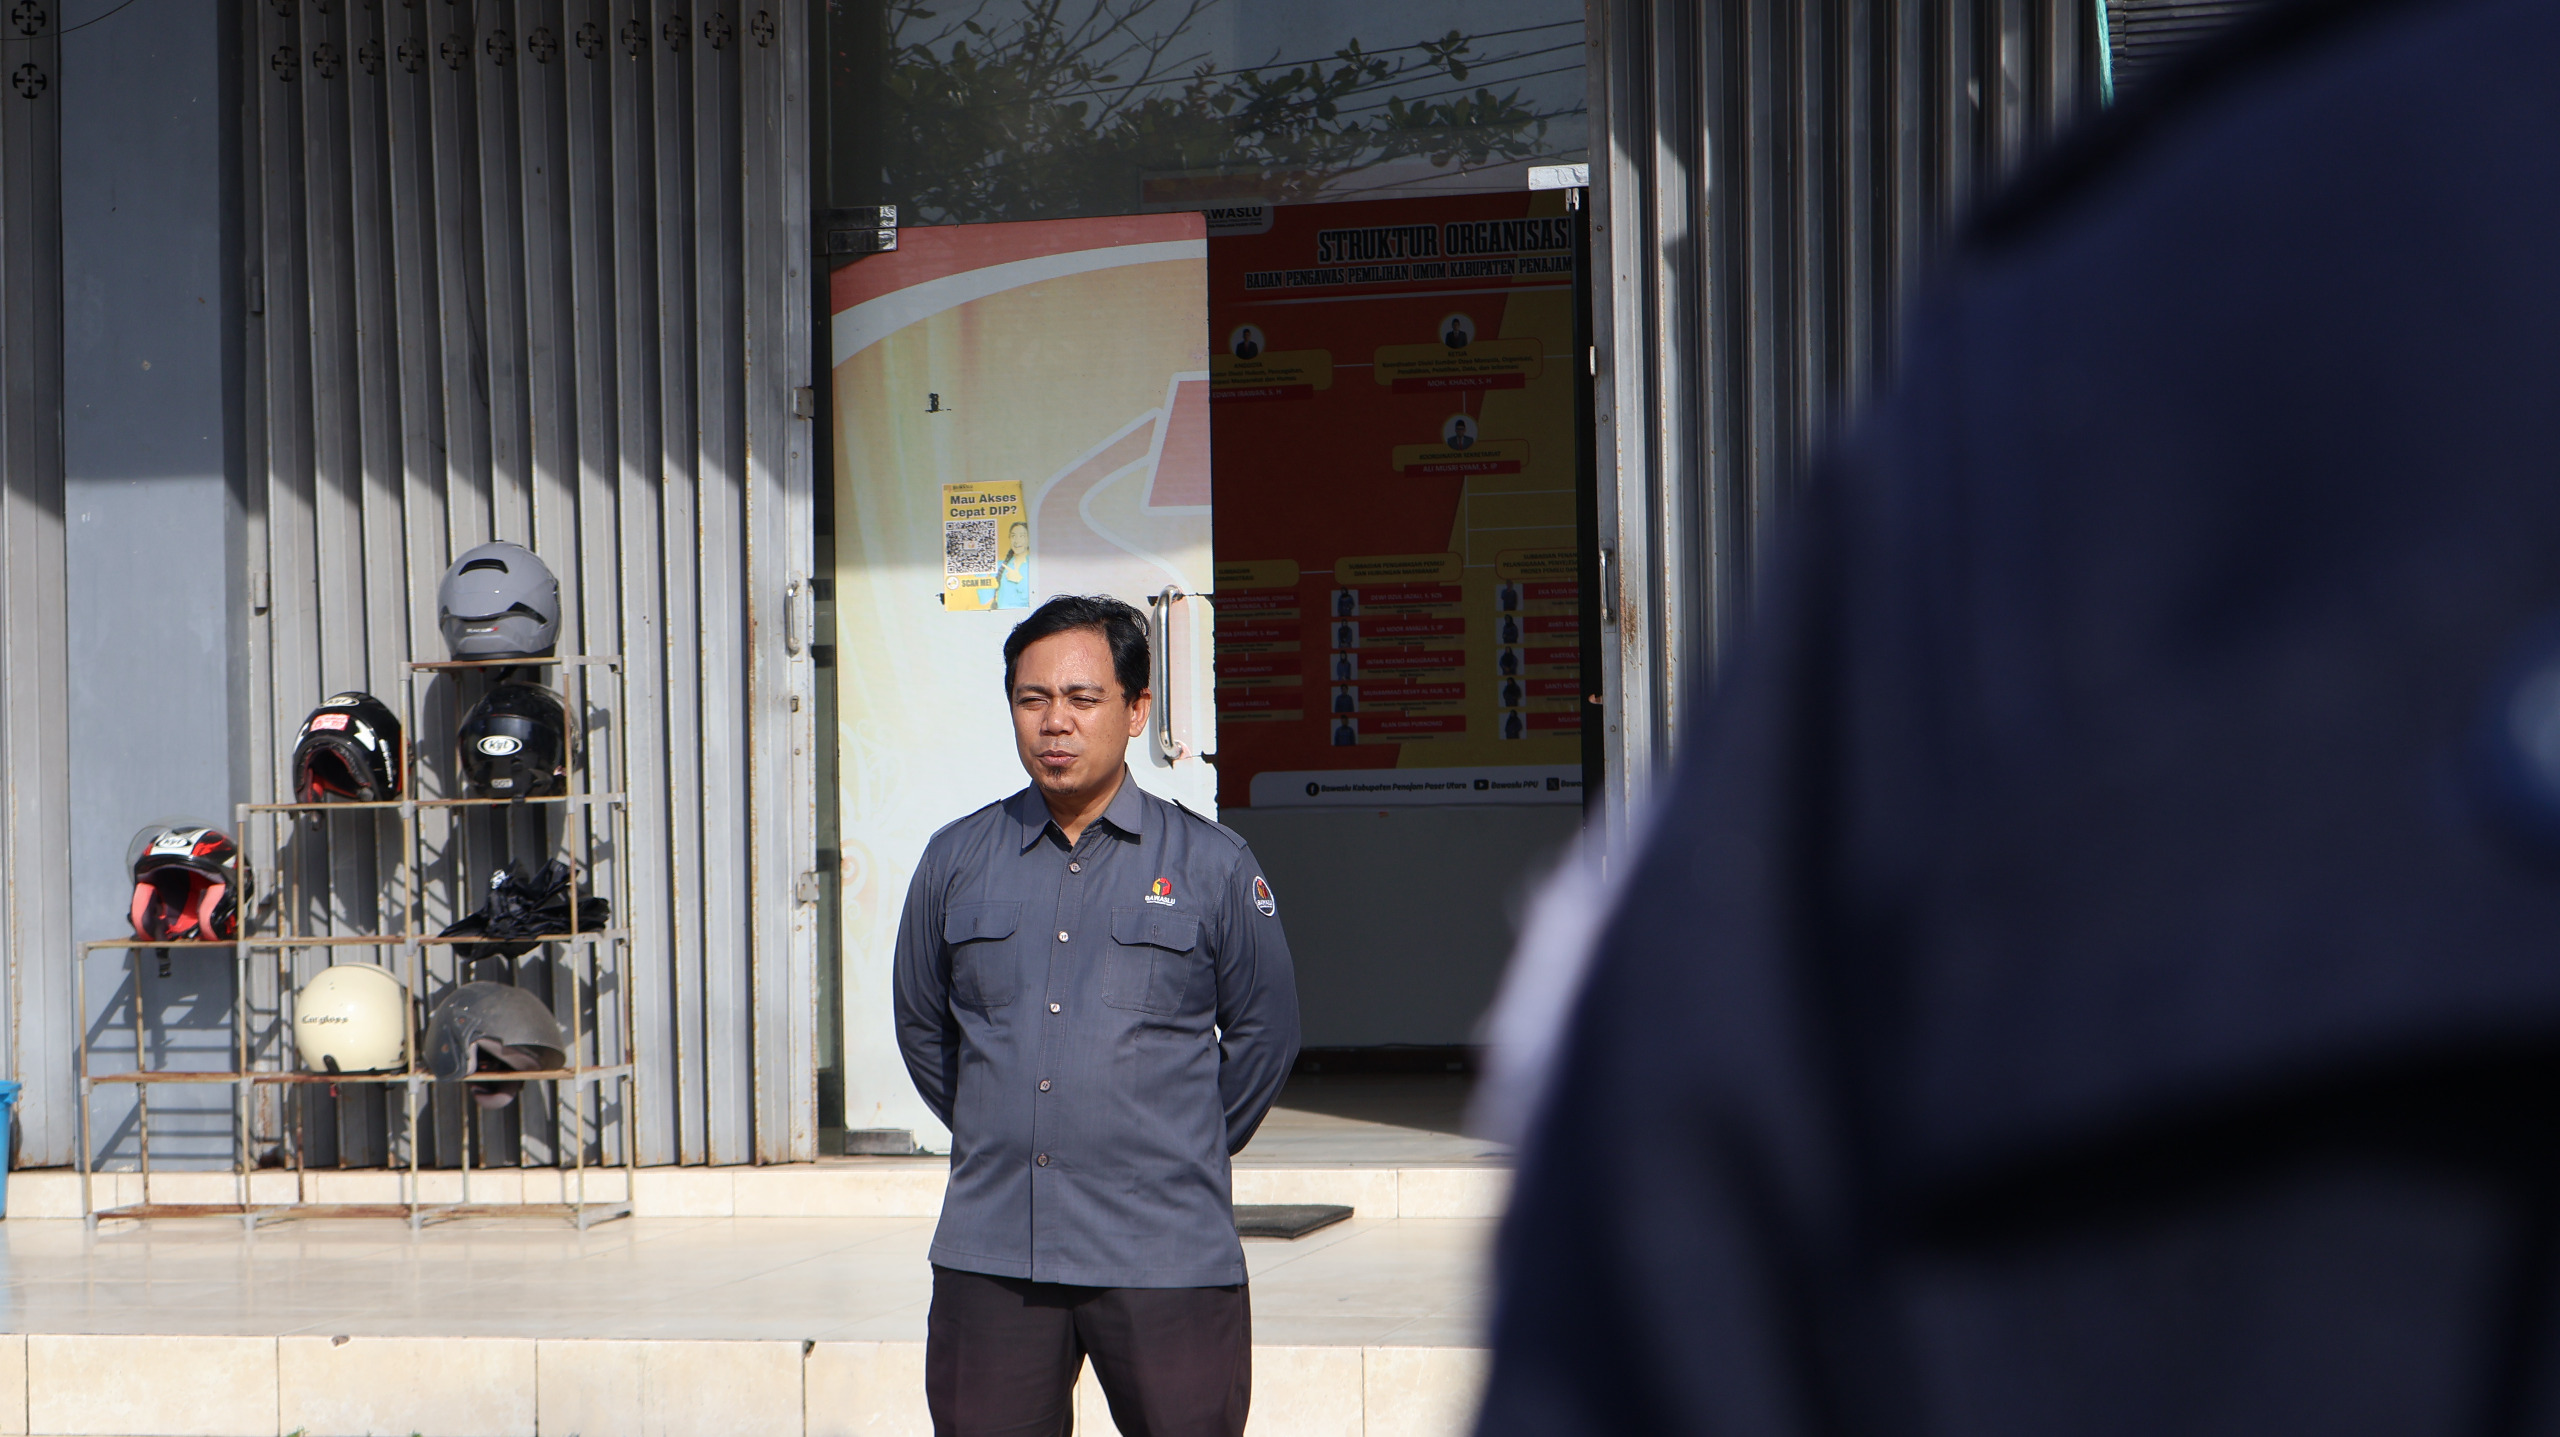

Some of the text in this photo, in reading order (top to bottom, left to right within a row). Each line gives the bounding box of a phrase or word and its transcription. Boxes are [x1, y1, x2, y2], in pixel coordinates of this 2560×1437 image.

[1318, 225, 1438, 262] STRUKTUR
[1246, 256, 1571, 289] BADAN PENGAWAS PEMILIHAN UMUM KABUPATEN PENAJAM
[950, 493, 1017, 505] Mau Akses
[950, 505, 1017, 518] Cepat DIP?
[961, 578, 992, 587] SCAN ME!
[1321, 781, 1467, 792] Bawaslu Kabupaten Penajam Paser Utara
[1491, 780, 1539, 789] Bawaslu PPU
[1144, 895, 1176, 905] BAWASLU
